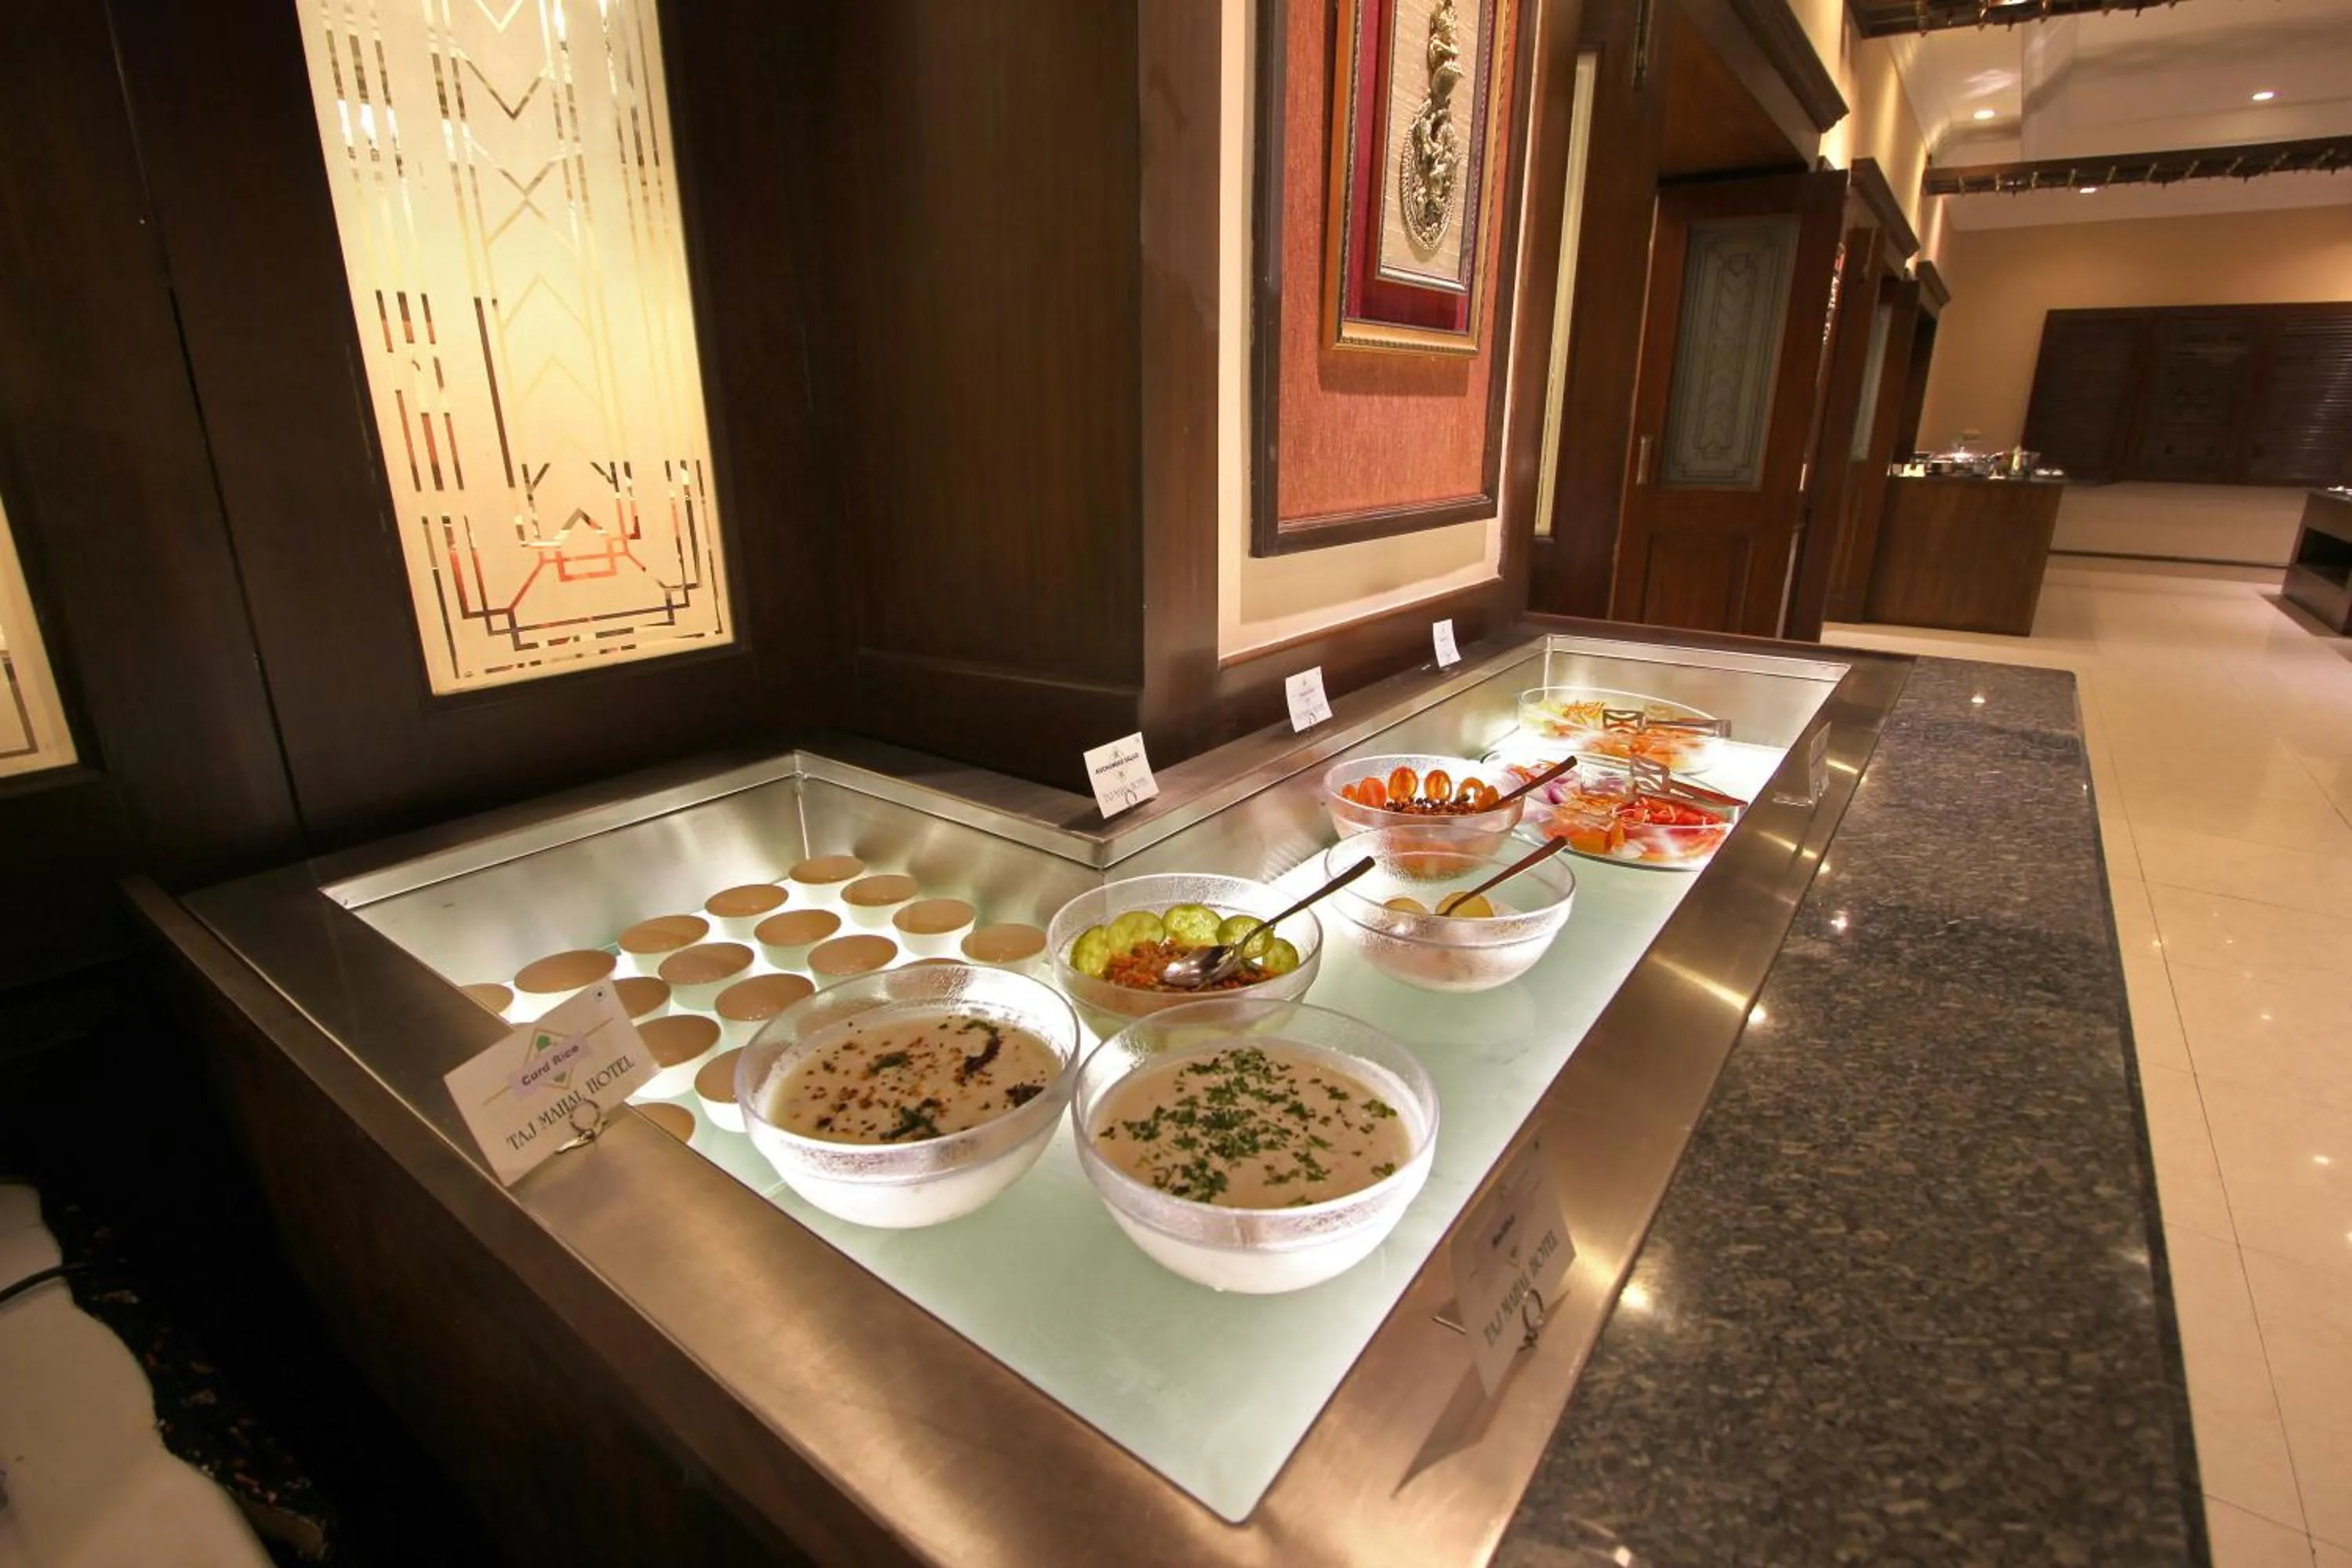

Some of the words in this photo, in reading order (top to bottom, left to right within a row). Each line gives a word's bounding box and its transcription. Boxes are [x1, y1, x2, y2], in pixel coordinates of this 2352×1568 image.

[521, 1064, 550, 1087] Curd
[552, 1044, 579, 1063] Rice
[506, 1123, 537, 1151] TAJ
[539, 1091, 586, 1130] MAHAL
[586, 1055, 635, 1095] HOTEL
